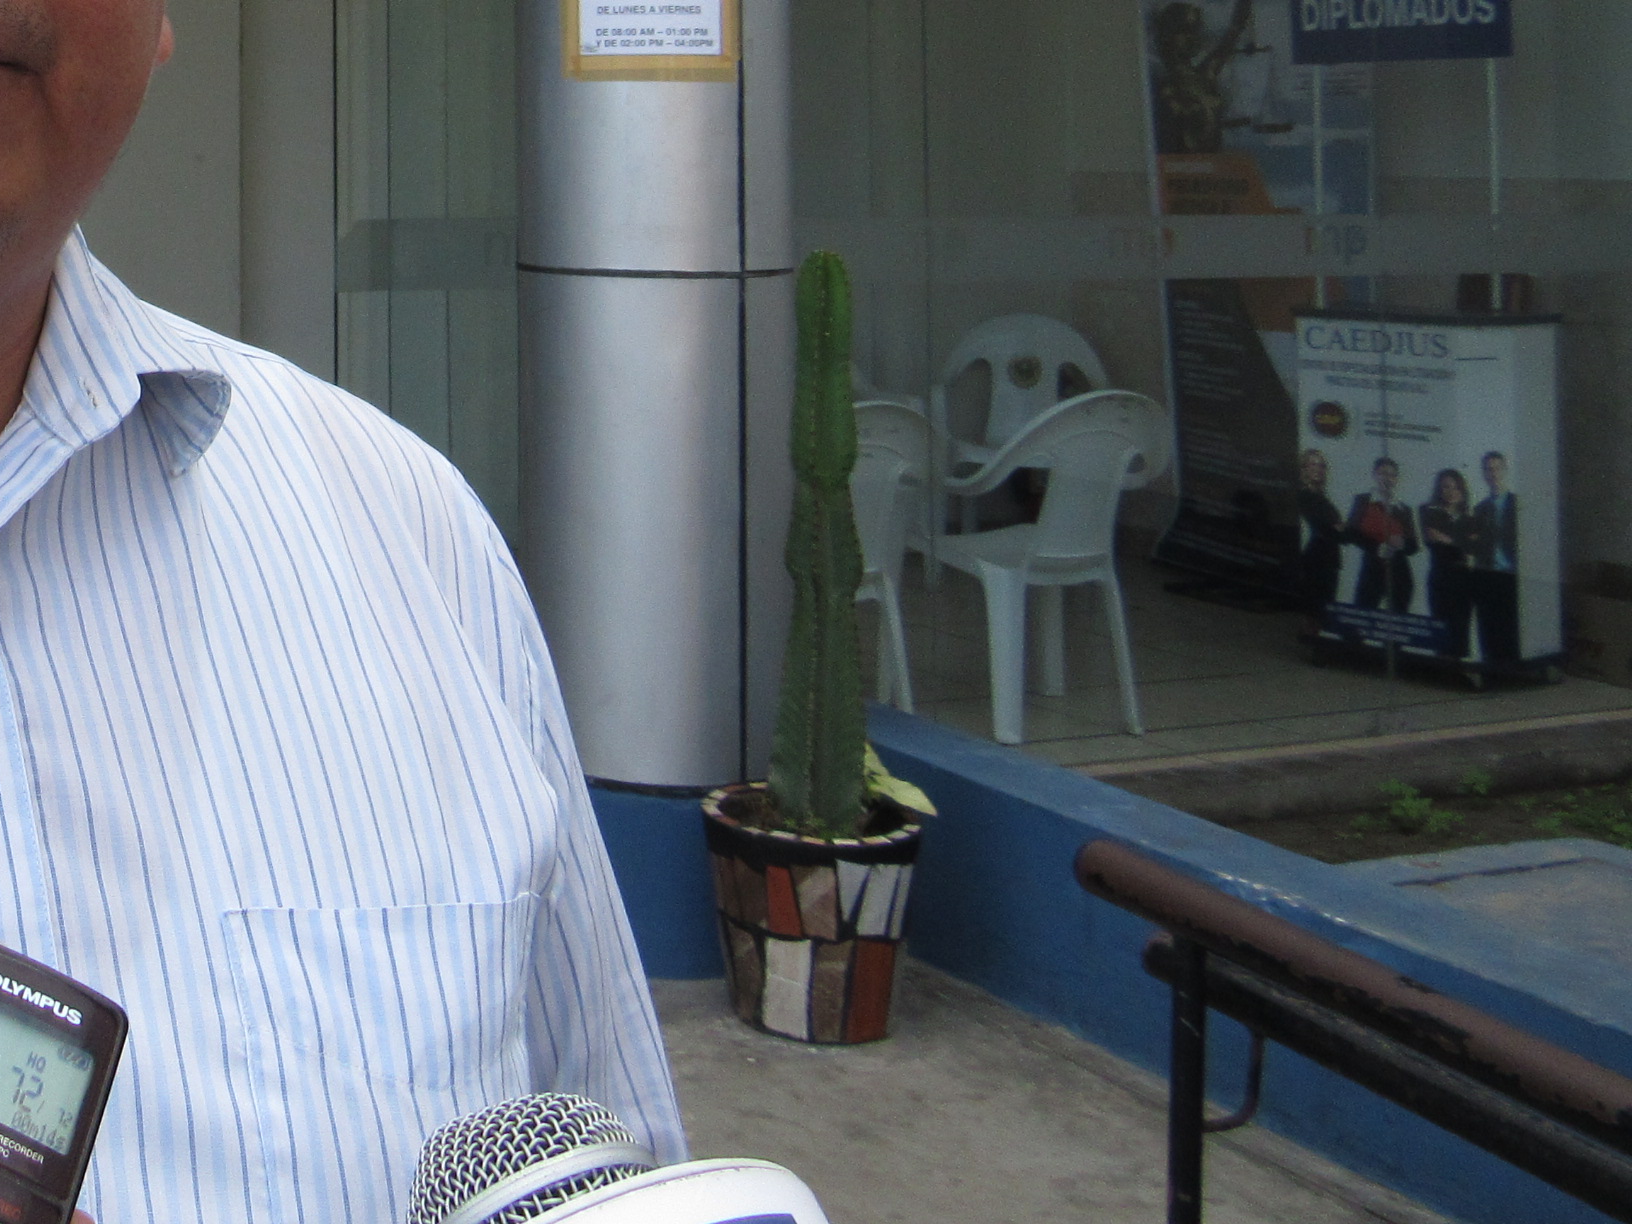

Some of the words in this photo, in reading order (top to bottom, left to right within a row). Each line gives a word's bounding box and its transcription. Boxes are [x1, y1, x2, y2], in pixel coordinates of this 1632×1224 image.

[597, 6, 609, 14] DE
[613, 5, 646, 14] LUNES
[649, 5, 656, 13] A
[658, 5, 701, 14] VIERNES
[596, 28, 609, 36] DE
[640, 28, 654, 36] AM
[694, 28, 708, 36] PM
[649, 39, 663, 47] PM
